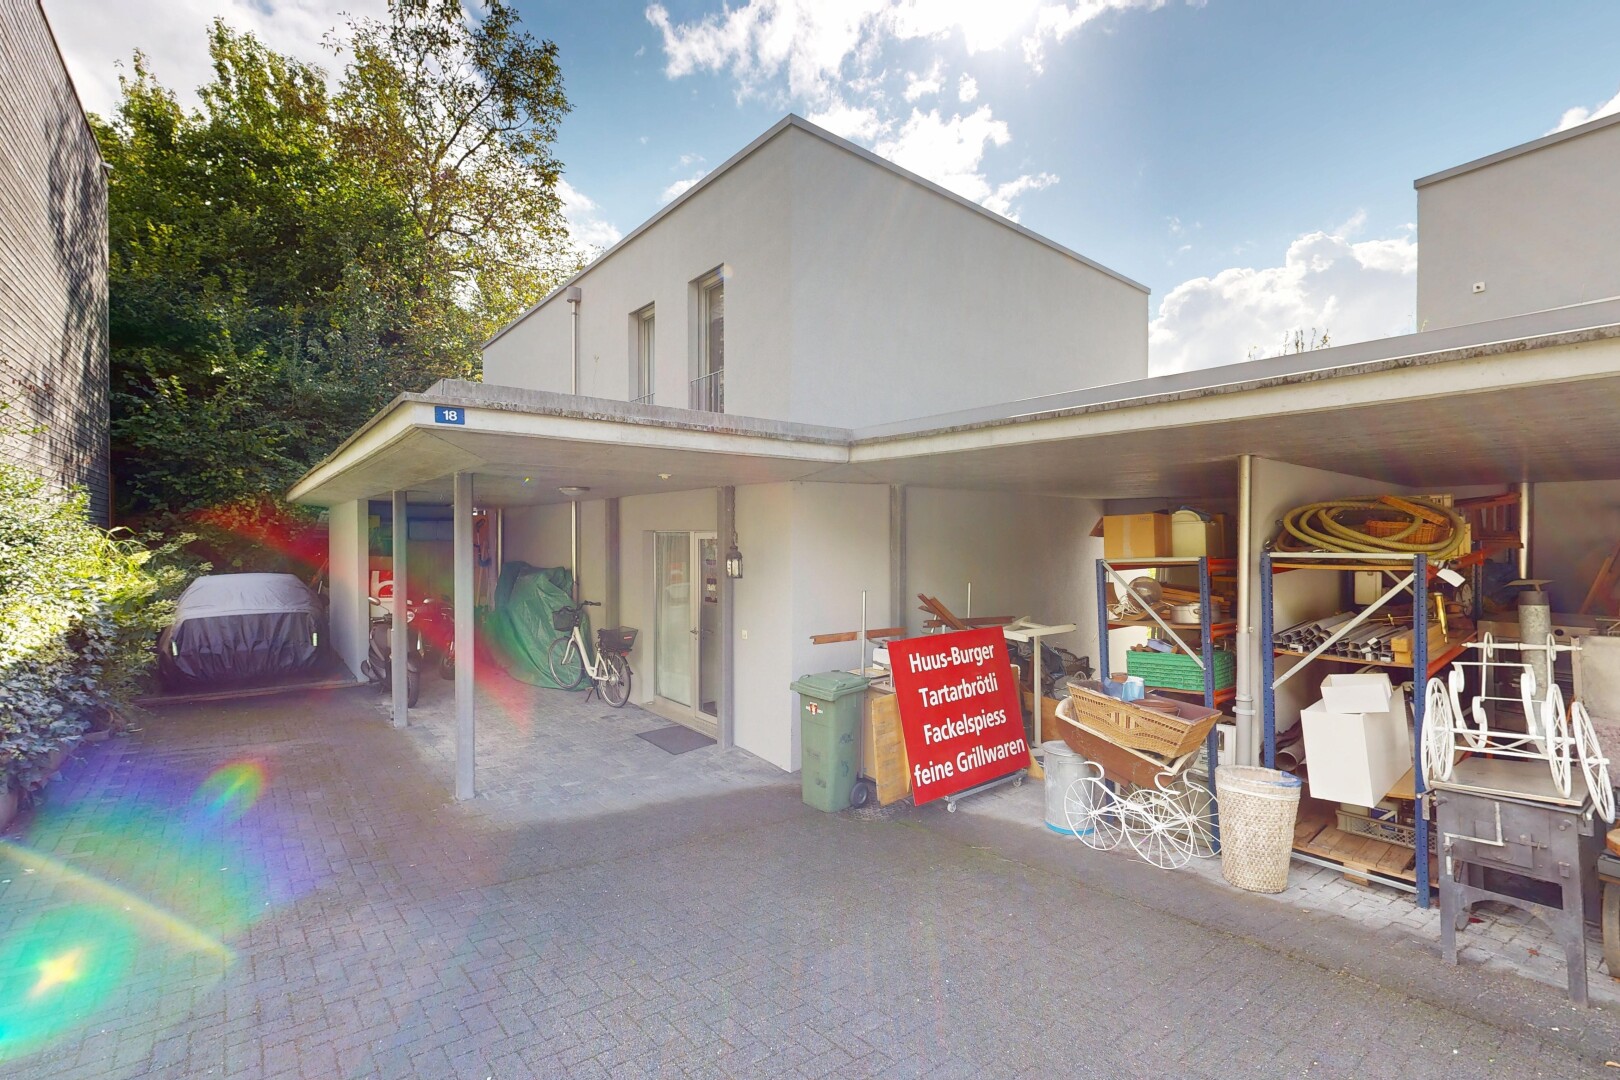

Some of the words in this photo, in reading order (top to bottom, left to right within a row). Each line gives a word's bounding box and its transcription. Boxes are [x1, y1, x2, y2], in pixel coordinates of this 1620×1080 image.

[442, 409, 458, 421] 18
[908, 644, 995, 674] Huus-Burger
[918, 672, 999, 708] Tartarbrötli
[923, 708, 1007, 745] Fackelspiess
[913, 760, 954, 787] feine
[956, 738, 1026, 773] Grillwaren
